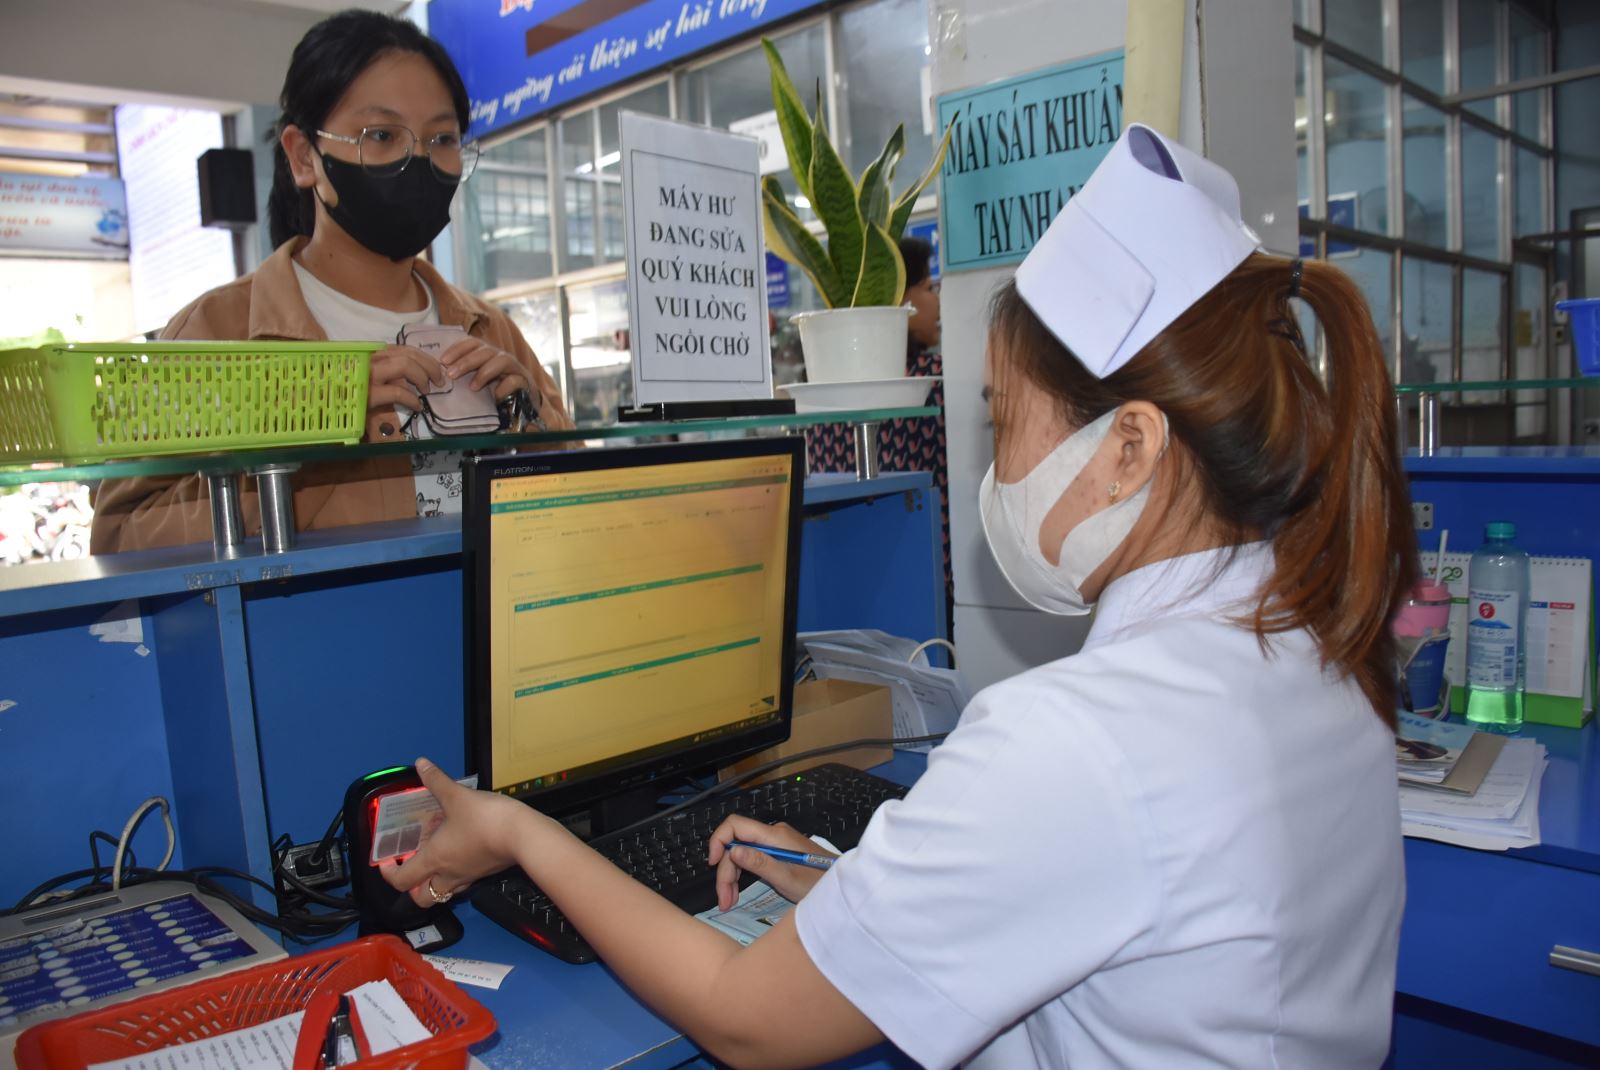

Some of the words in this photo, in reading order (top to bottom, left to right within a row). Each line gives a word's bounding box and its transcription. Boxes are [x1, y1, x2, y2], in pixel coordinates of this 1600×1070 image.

[589, 37, 638, 69] thiện
[644, 19, 673, 51] sự
[945, 102, 992, 177] MÁY
[996, 89, 1038, 165] SÁT
[659, 183, 703, 212] MÁY
[708, 195, 736, 217] HƯ
[650, 221, 705, 248] ĐANG
[710, 226, 746, 253] SỬA
[974, 196, 1014, 256] TAY
[641, 255, 684, 284] QUÝ
[690, 260, 755, 288] KHÁCH
[655, 295, 689, 318] VUI
[695, 293, 747, 321] LÒNG
[710, 331, 750, 356] CHỜ
[494, 465, 534, 476] FLATRON
